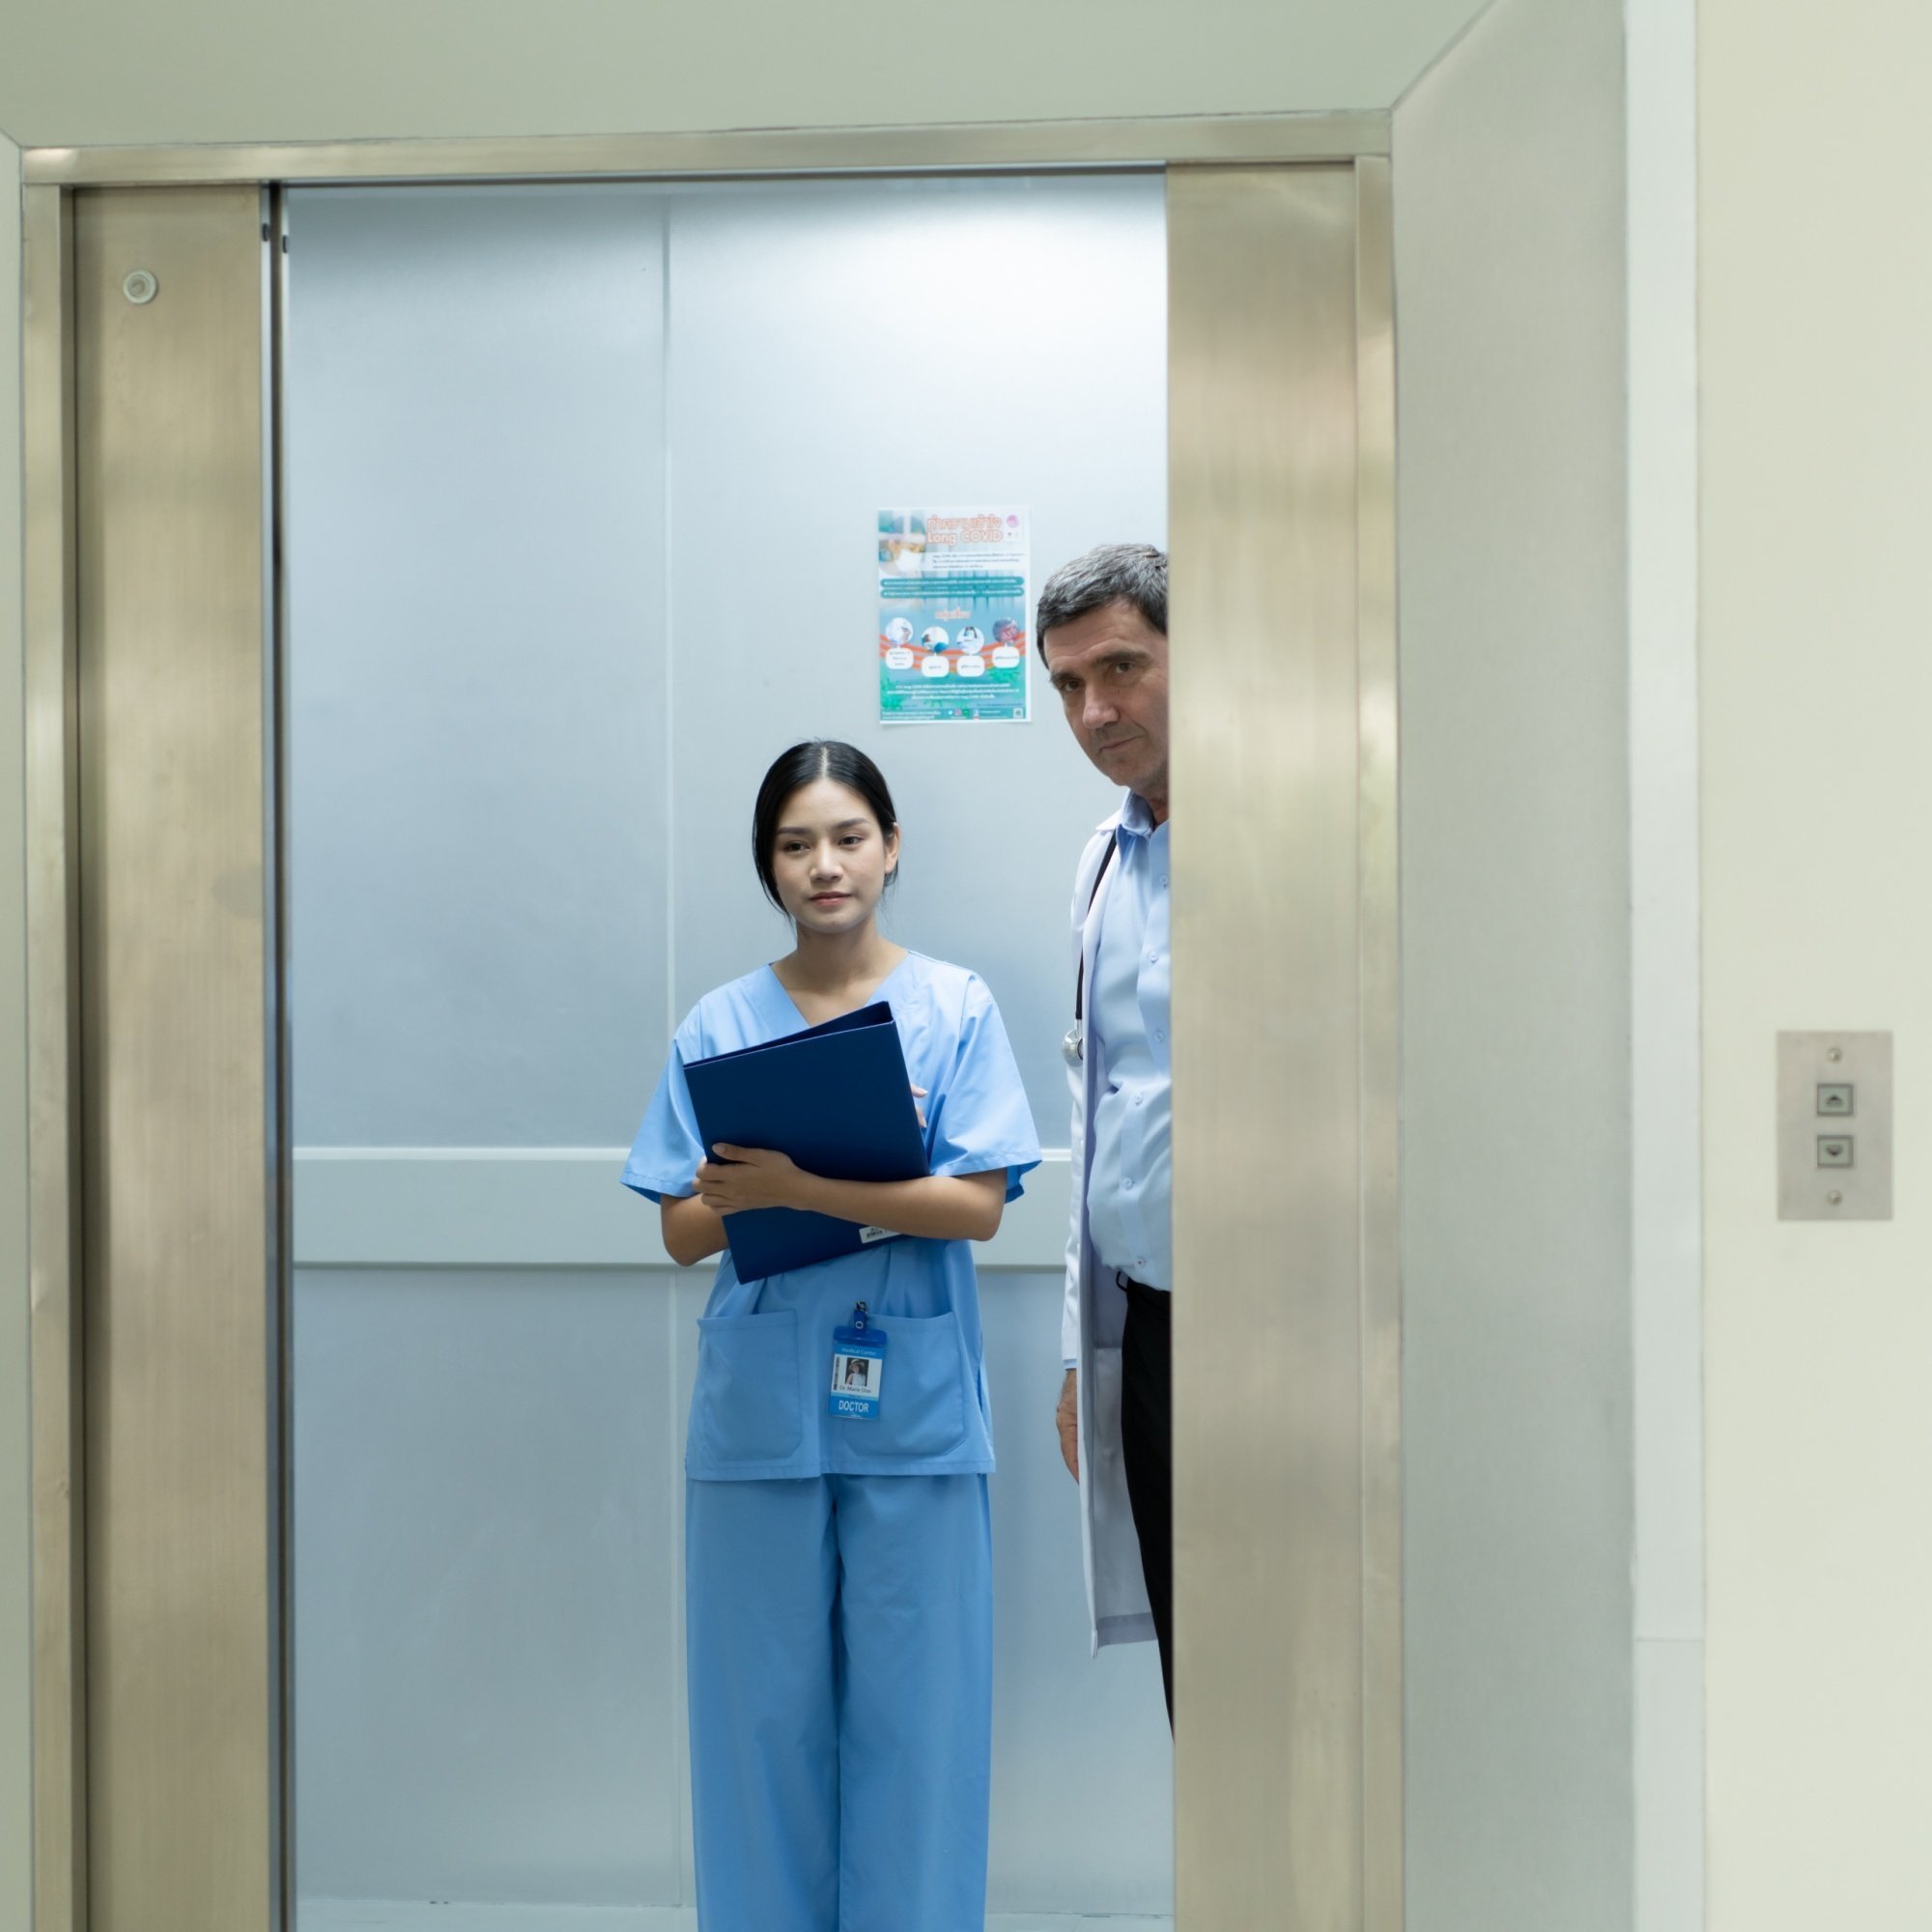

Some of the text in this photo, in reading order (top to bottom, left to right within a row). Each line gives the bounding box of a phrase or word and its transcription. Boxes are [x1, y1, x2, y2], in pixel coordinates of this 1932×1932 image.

[927, 530, 1004, 546] Long COVID
[838, 1400, 869, 1413] DOCTOR
